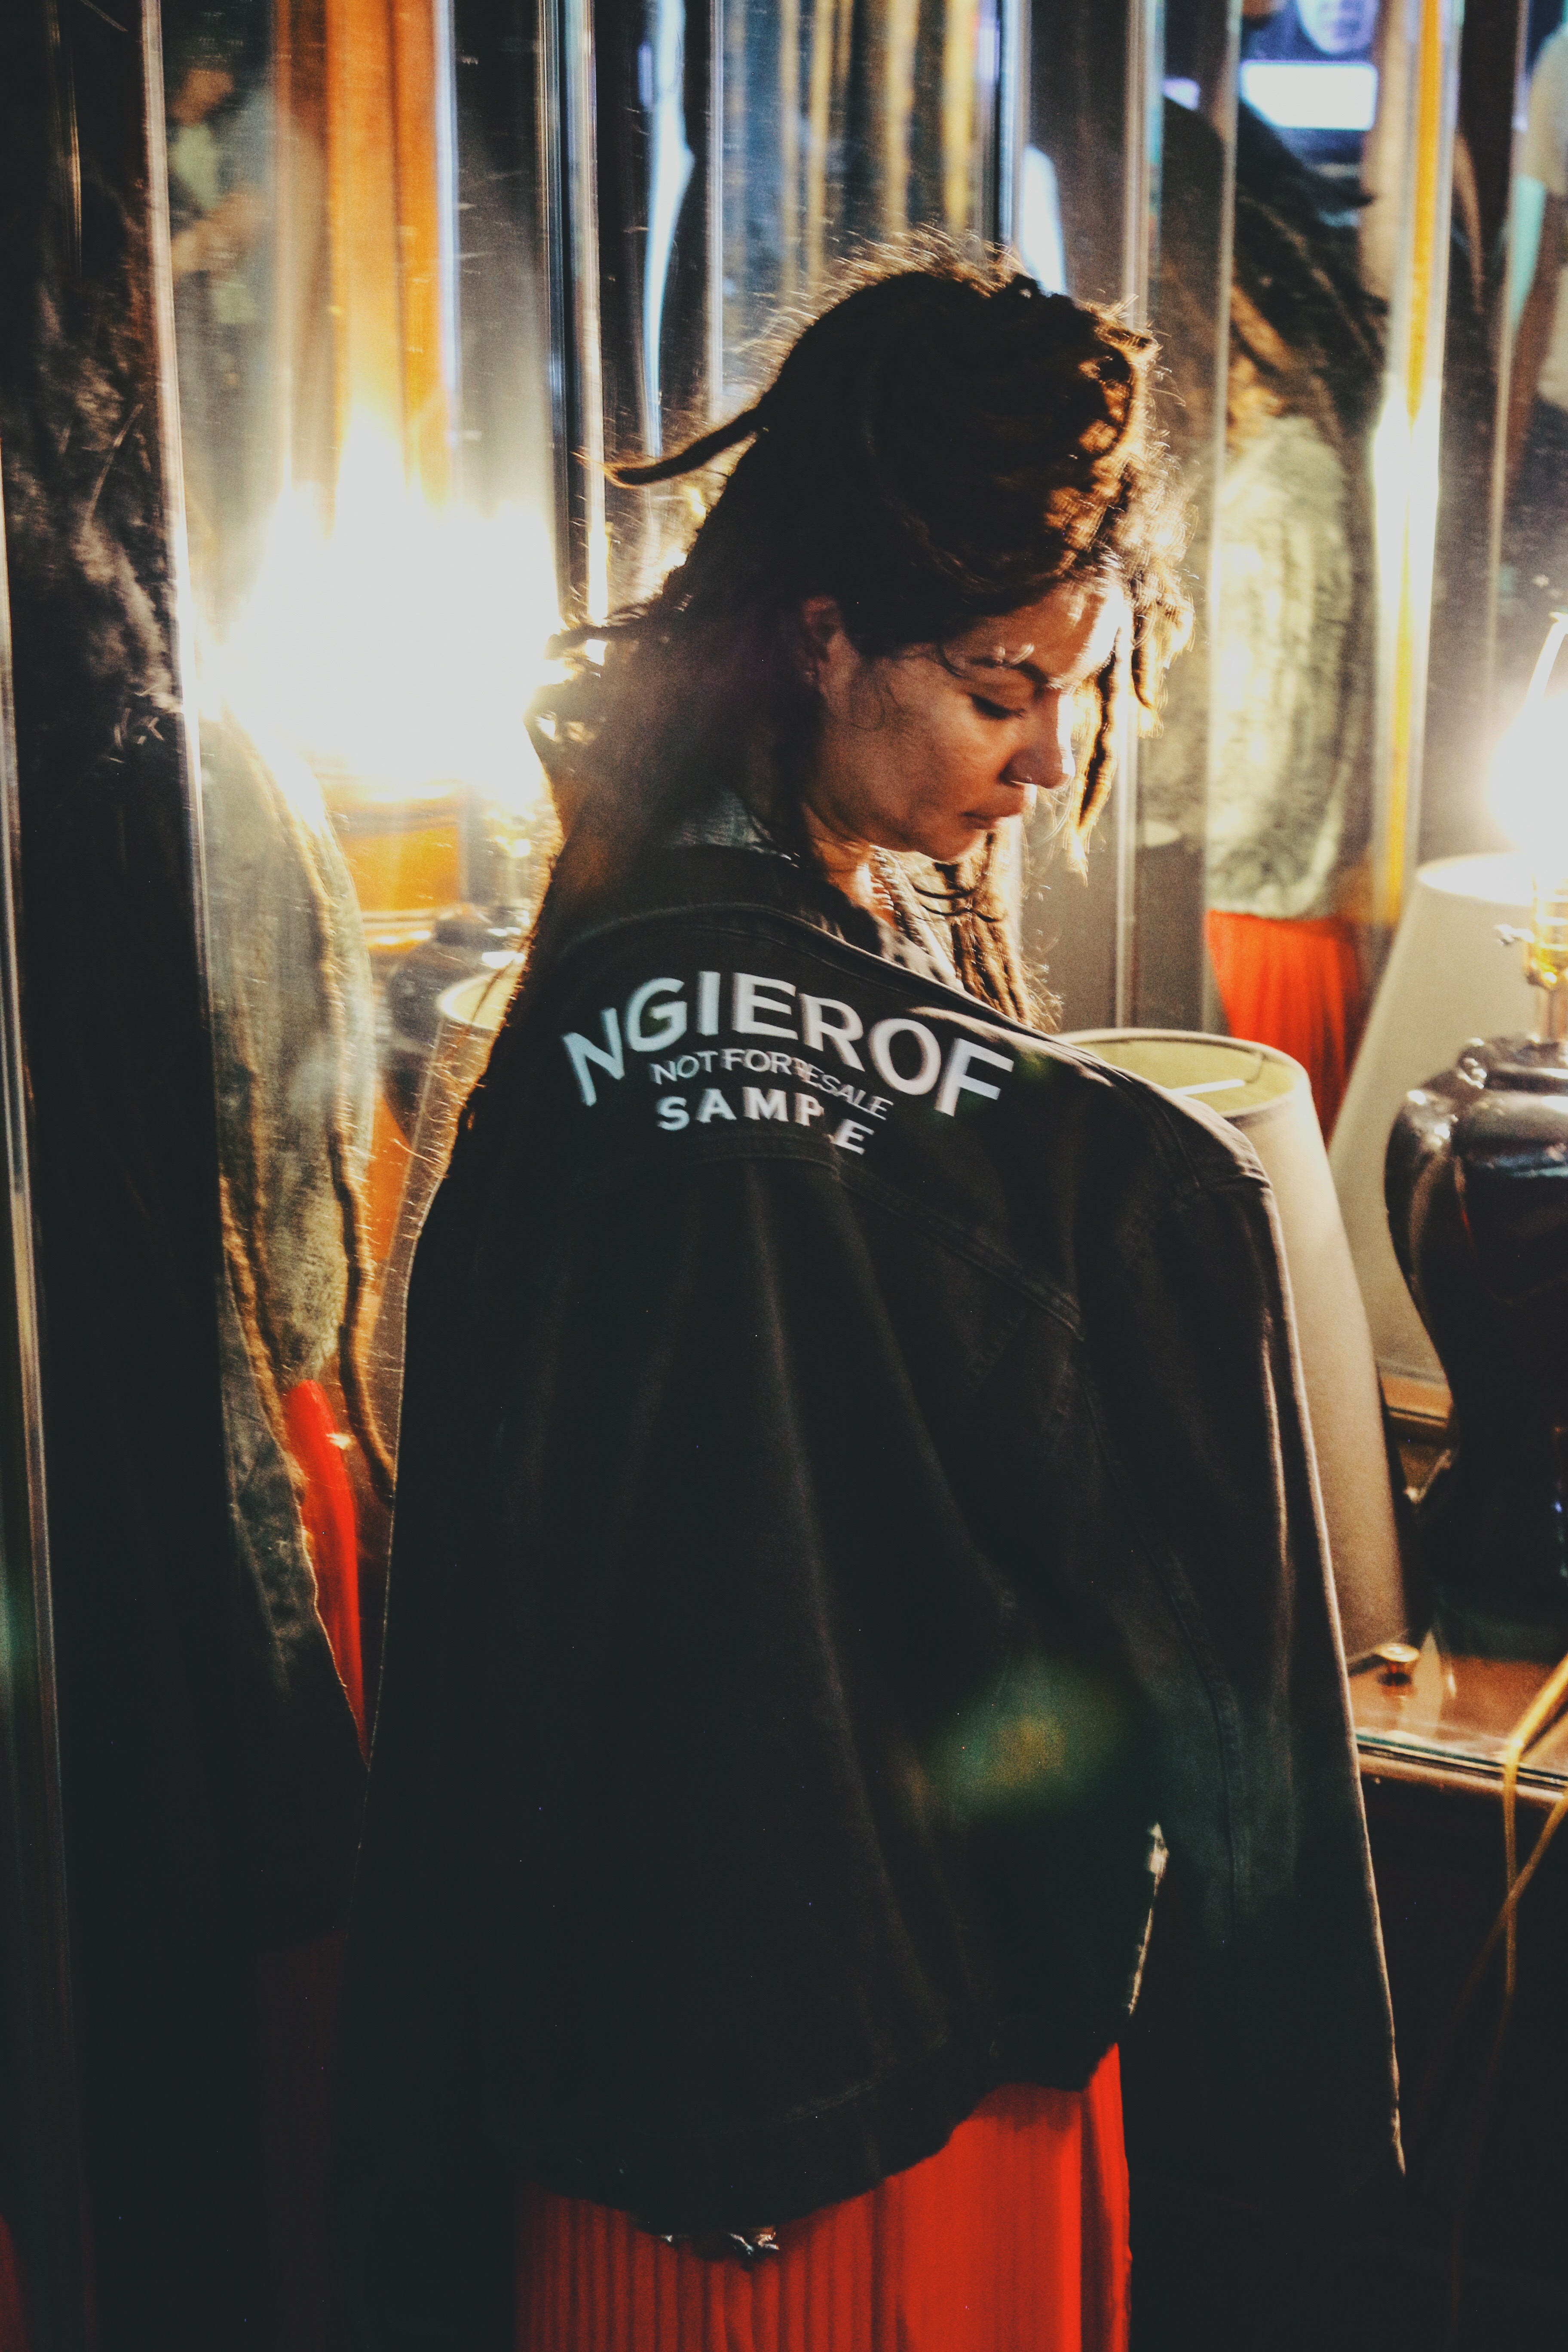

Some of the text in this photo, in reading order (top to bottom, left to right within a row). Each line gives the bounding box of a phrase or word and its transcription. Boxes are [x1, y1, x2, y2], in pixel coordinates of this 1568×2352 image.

[561, 970, 1014, 1117] NGIEROF
[650, 1050, 718, 1084] NOT
[720, 1048, 792, 1075] FOR
[656, 1087, 874, 1155] SAMPE
